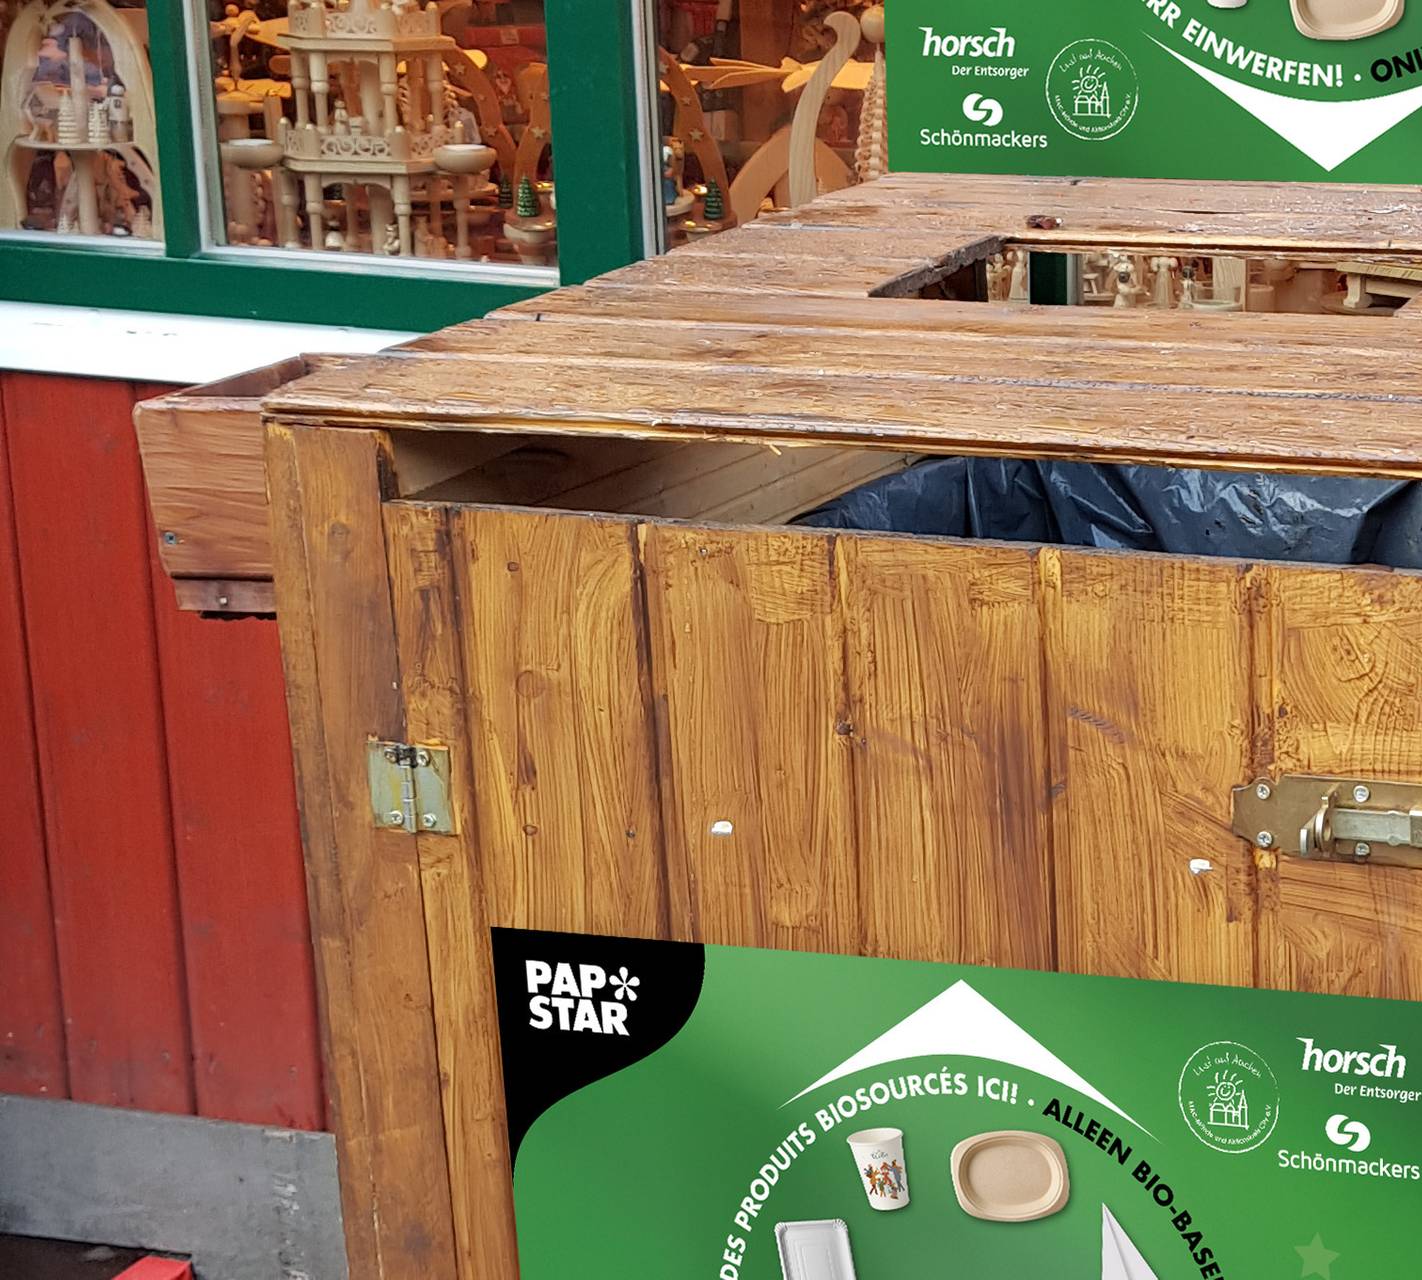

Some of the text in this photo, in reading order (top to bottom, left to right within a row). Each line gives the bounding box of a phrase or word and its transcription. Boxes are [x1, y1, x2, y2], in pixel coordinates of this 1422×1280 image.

[919, 26, 1016, 58] horsch
[1141, 0, 1344, 88] RR EINWERFEN!
[951, 65, 1030, 80] Der Entsorger
[920, 128, 1048, 148] Schönmackers
[525, 959, 607, 998] PAP
[528, 995, 631, 1036] STAR
[1296, 1037, 1407, 1079] horsch
[1334, 1082, 1422, 1104] Der Entsorger
[719, 1066, 1019, 1280] DES PRODUITS BIOSOURCÉS ICI!
[1278, 1149, 1421, 1180] Schönmackers
[1042, 1098, 1225, 1280] ALLEEN BIO-BASE
